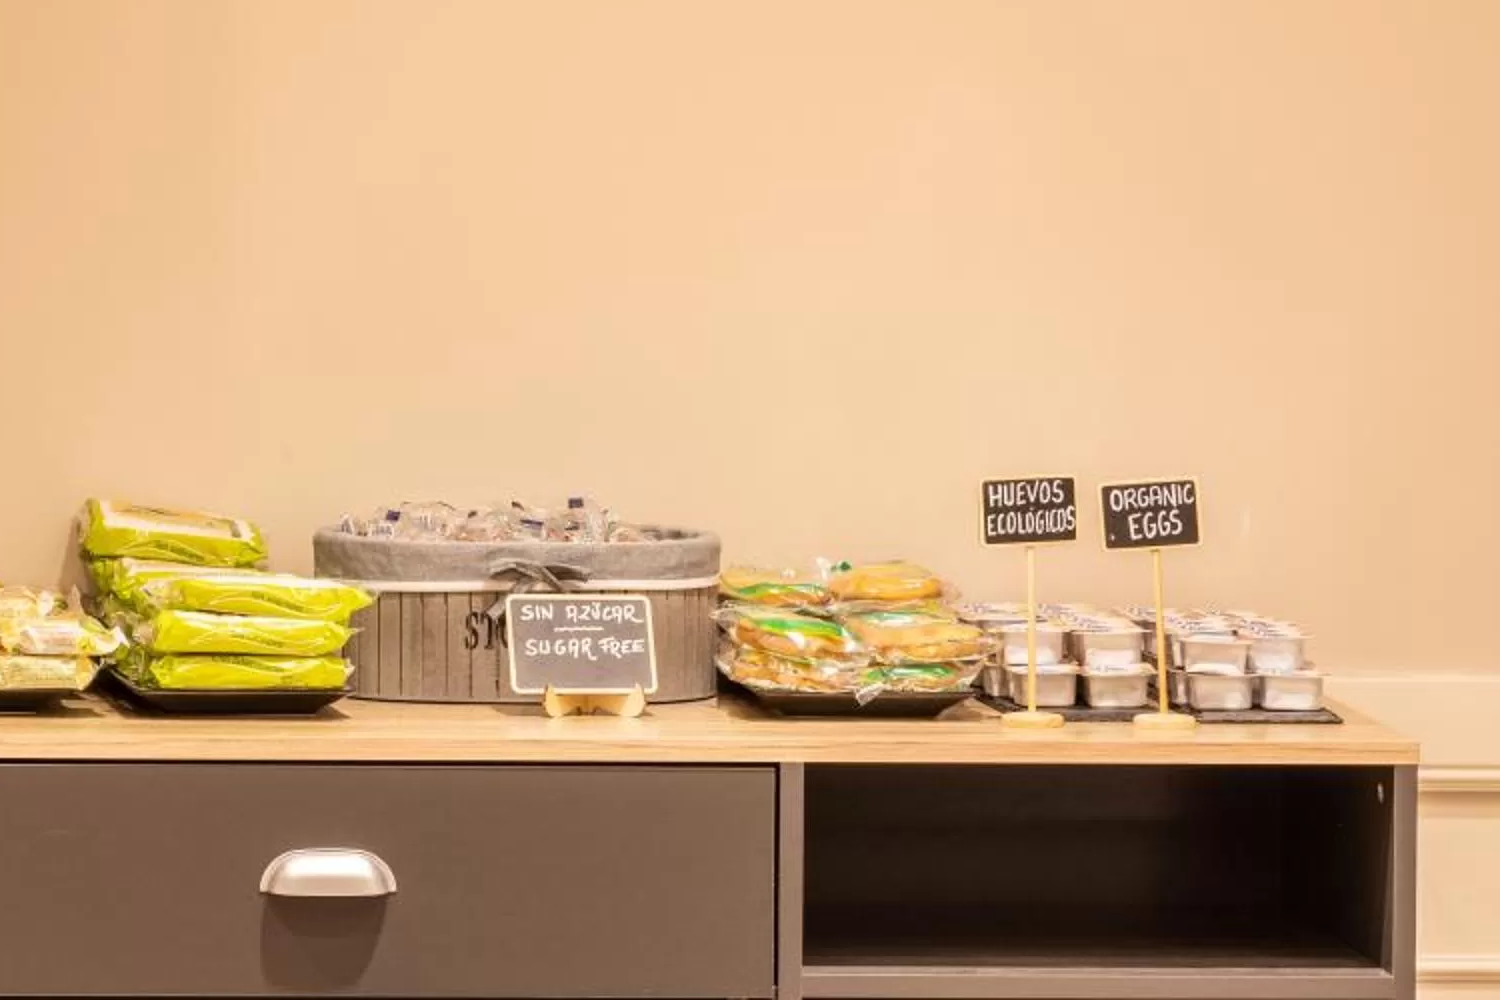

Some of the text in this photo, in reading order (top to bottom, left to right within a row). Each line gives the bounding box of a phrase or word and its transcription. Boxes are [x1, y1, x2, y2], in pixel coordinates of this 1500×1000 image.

[987, 479, 1065, 507] HUEVOS
[1109, 482, 1195, 512] ORGANIC
[986, 505, 1075, 537] ECOLÓGICOS
[1127, 509, 1183, 541] EGGS
[520, 603, 555, 622] SIN
[524, 636, 646, 661] SUGAR FREE
